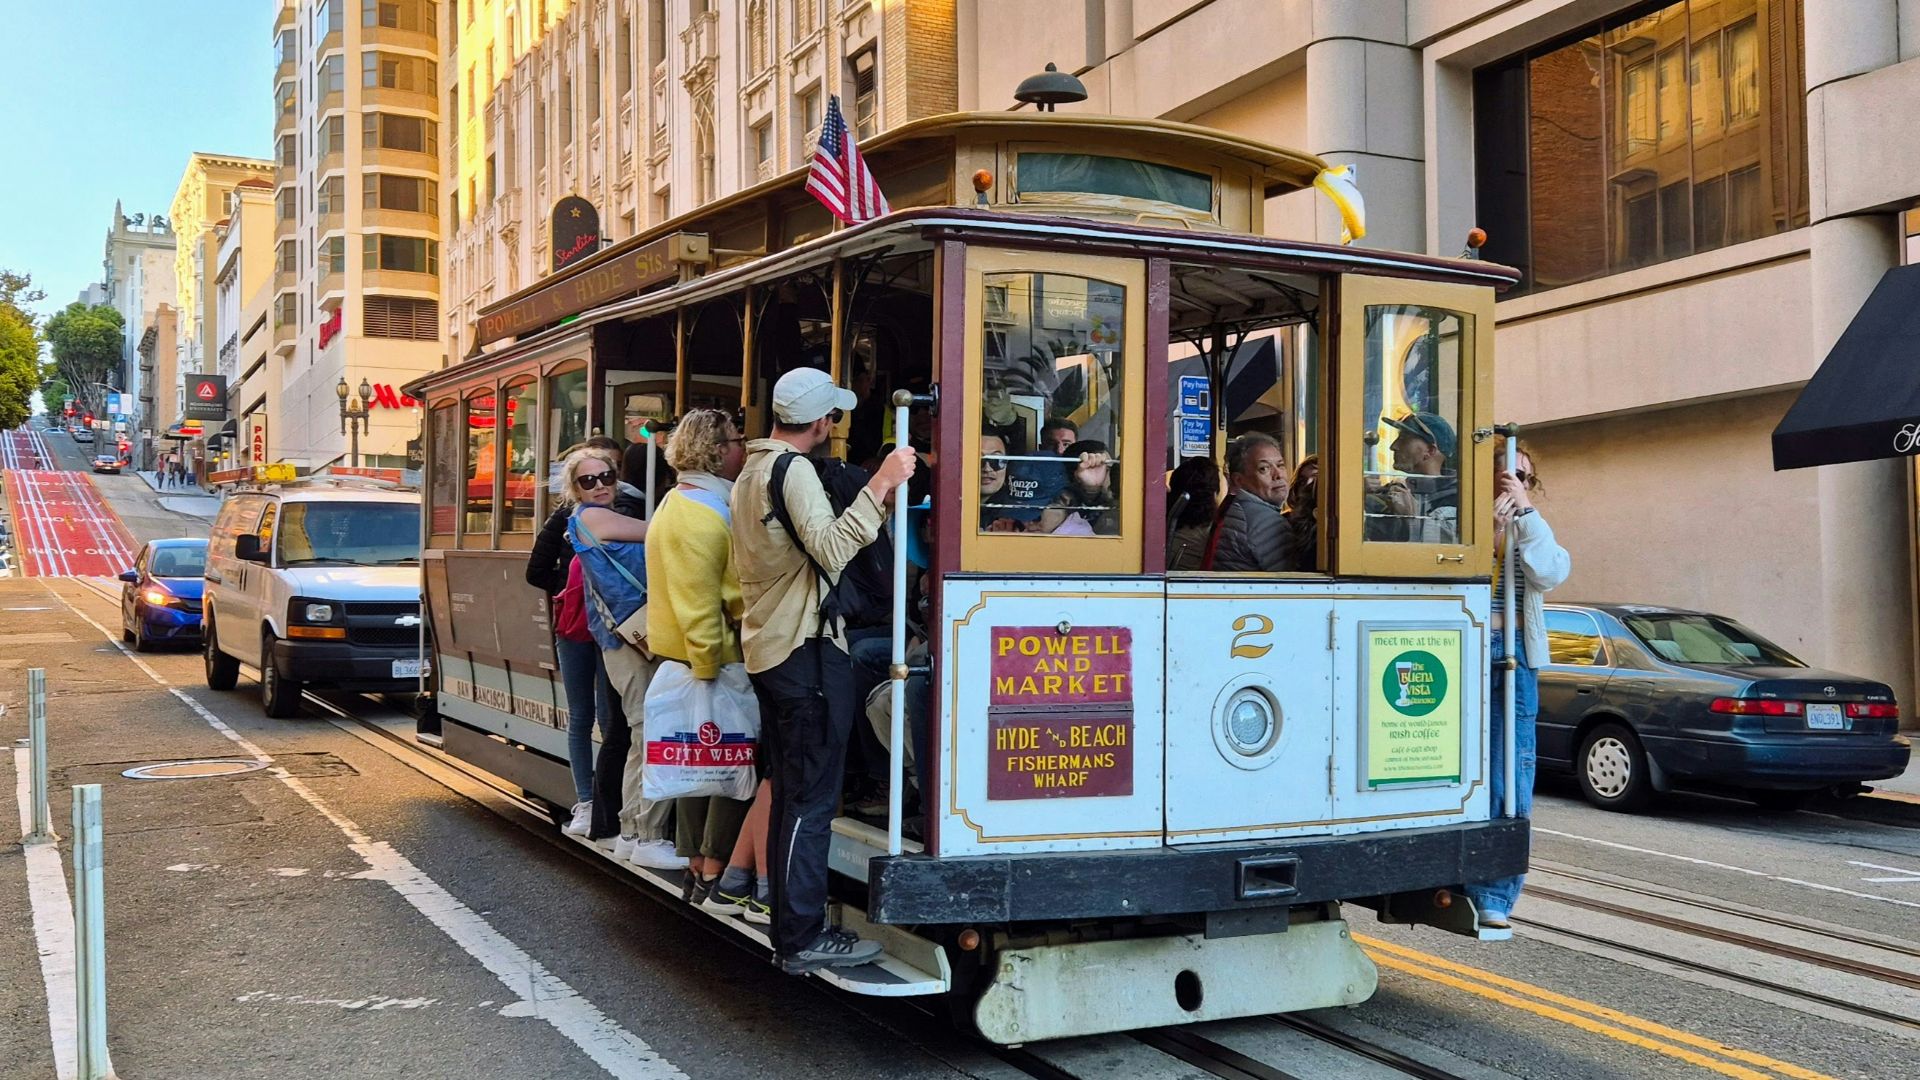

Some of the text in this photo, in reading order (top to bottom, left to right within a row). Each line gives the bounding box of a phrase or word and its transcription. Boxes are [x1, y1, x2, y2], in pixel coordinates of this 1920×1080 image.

[556, 234, 597, 265] Starlite
[485, 299, 541, 337] POWELL
[553, 291, 565, 313] &
[574, 263, 625, 301] HYDE
[1184, 381, 1195, 389] Pay
[1184, 420, 1204, 429] Pay by
[254, 426, 263, 461] PARK
[1009, 487, 1034, 498] Paris
[997, 635, 1126, 657] POWELL
[1231, 613, 1274, 659] 2
[1034, 657, 1092, 673] AND
[457, 680, 469, 697] SAN
[473, 685, 506, 710] RANCISCO
[996, 674, 1126, 696] MARKET
[701, 724, 719, 743] SF
[996, 725, 1127, 750] HYDE AND BEACH
[663, 747, 754, 762] CITY WEAR
[1007, 753, 1115, 772] FISHERMANS
[1034, 772, 1089, 788] WHARF
